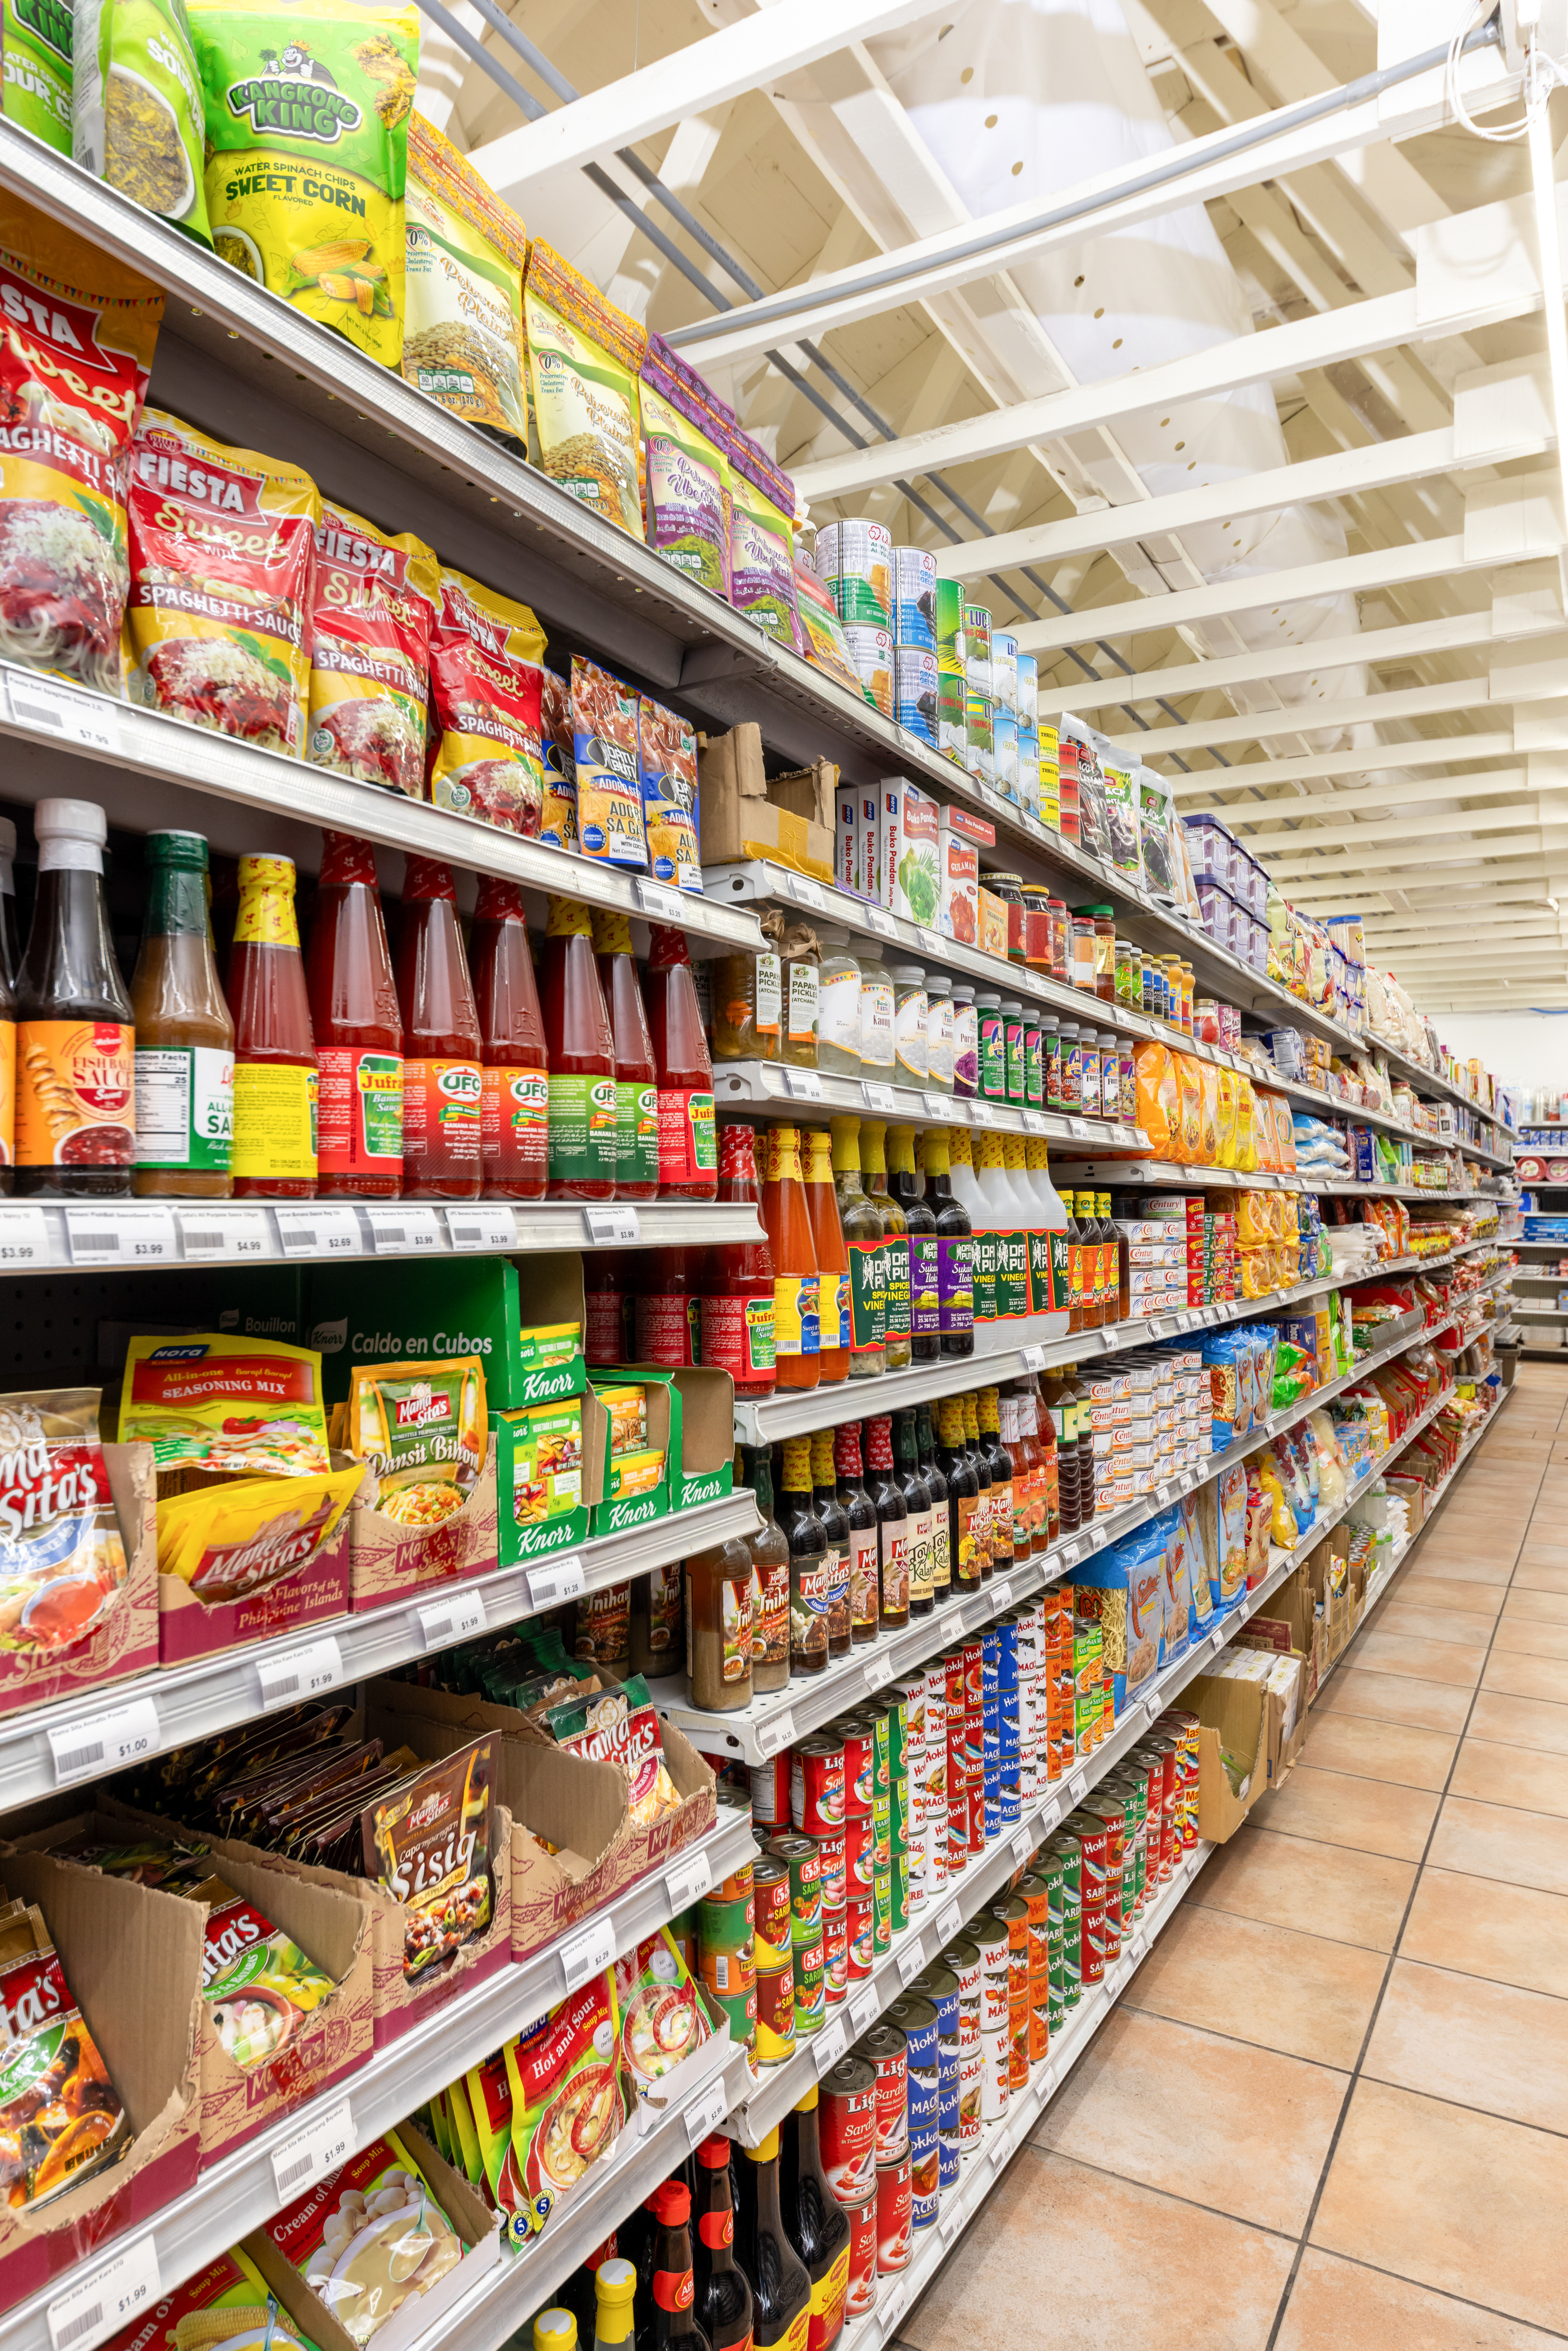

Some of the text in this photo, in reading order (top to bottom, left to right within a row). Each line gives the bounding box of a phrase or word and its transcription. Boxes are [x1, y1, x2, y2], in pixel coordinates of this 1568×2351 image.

[230, 81, 359, 125] KANGKONG
[257, 100, 339, 136] KING
[235, 162, 355, 190] WATER SPINACH CHIPS
[226, 175, 366, 218] SWEET CORN
[273, 194, 313, 207] FLAVORED
[442, 163, 519, 238] EXPORT QUALITY EXPORT QUALITY
[409, 230, 428, 247] 0%
[405, 250, 437, 261] Preservatives
[405, 257, 433, 265] Cholesterol
[440, 257, 510, 326] Polvoron
[538, 260, 602, 319] EXPORT QUALITY EXPORT QUALITY
[457, 292, 506, 340] Plain
[544, 354, 560, 370] 0%
[539, 372, 568, 381] Preservatives
[460, 395, 474, 406] (170
[475, 398, 484, 409] g.)
[570, 377, 629, 430] Polvoron
[586, 406, 625, 443] Plain
[149, 434, 179, 447] WHITE
[152, 442, 176, 453] KING
[139, 452, 246, 513] FIESTA
[667, 473, 700, 499] Ube
[677, 457, 722, 504] Polvoron
[154, 502, 289, 558] Sweet
[315, 527, 396, 577] FIESTA
[324, 572, 416, 629] Sweet
[140, 584, 303, 642] SPAGHETTI SAUCE
[318, 651, 404, 686] SPAGHETTI
[44, 688, 72, 701] Spaghetti
[74, 698, 90, 707] Sauce
[80, 729, 109, 744] $7.99
[459, 715, 523, 751] SPAGHETTI
[598, 778, 627, 794] ADOBO
[907, 811, 938, 826] Buko Pandan
[1140, 807, 1159, 822] BLACK
[606, 817, 625, 833] SA
[973, 821, 984, 831] Pandan
[1214, 846, 1228, 864] Otap
[951, 861, 976, 872] GULAMAN
[668, 910, 681, 918] $3.25
[1215, 907, 1229, 924] Otap
[792, 981, 817, 991] PAPAYA
[792, 988, 817, 999] PICKLES
[792, 997, 816, 1006] (ATCHARA)
[873, 1015, 891, 1028] Kaong
[960, 1033, 976, 1044] Purple
[73, 1057, 105, 1068] FISH
[162, 1053, 187, 1062] Facts
[73, 1069, 133, 1088] SAUCE
[175, 1076, 187, 1084] 25
[362, 1075, 403, 1089] Jufra
[443, 1075, 480, 1092] UFC
[515, 1083, 547, 1098] UFC
[1148, 1200, 1179, 1211] Century
[135, 1244, 162, 1254] $3.99
[237, 1242, 260, 1251] $4.99
[329, 1239, 350, 1247] $2.69
[1, 1248, 32, 1258] $3.99
[959, 1273, 972, 1283] Iloko
[245, 1317, 295, 1333] Bouillon
[312, 1332, 344, 1345] Knorr
[352, 1332, 493, 1354] Caldo en Cubos
[163, 1369, 223, 1382] All-in-one
[162, 1381, 285, 1398] SEASONING MIX
[523, 1373, 575, 1401] Knorr
[399, 1395, 432, 1422] Mama
[416, 1401, 447, 1429] Sita's
[532, 1418, 569, 1432] VEGETABLE BOUILLON
[367, 1435, 479, 1478] Pansit Bihon
[681, 1480, 722, 1506] Knorr
[609, 1500, 657, 1530] Knorr
[199, 1530, 293, 1586] Mama
[909, 1541, 932, 1564] Toyo
[237, 1532, 315, 1591] Sita's
[275, 1579, 340, 1600] Flavors of the
[564, 1584, 579, 1595] $1.25
[305, 1588, 343, 1609] Islands
[811, 1600, 824, 1610] ADOBO
[462, 1617, 479, 1630] $1.99
[311, 1674, 333, 1688] $1.99
[782, 1731, 792, 1741] $4.25
[119, 1738, 147, 1757] $1.00
[410, 1799, 439, 1828] Mama
[424, 1797, 449, 1827] Sita's
[400, 1820, 458, 1863] Capampangan
[392, 1830, 476, 1903] Sisig
[444, 1877, 453, 1888] SPICE
[695, 1881, 706, 1893] $1.99
[639, 1940, 658, 1957] Soup Mix
[596, 1951, 609, 1965] $2.29
[233, 1954, 258, 1985] BAYABAS
[583, 2007, 608, 2031] Soup Mix
[523, 2033, 543, 2049] Kitchen
[532, 1996, 595, 2080] Hot and Sour
[835, 2044, 844, 2057] $1.50
[712, 2105, 723, 2120] $2.99
[273, 2147, 287, 2159] Mama
[288, 2141, 297, 2149] Sita
[307, 2121, 326, 2137] Sinigang
[325, 2108, 344, 2123] Bayabas
[848, 2135, 863, 2144] Tomato
[325, 2142, 345, 2163] $1.99
[352, 2146, 385, 2178] Soup Mix
[273, 2185, 328, 2242] Cream of
[287, 2200, 336, 2256] Crème de Champignons
[517, 2219, 525, 2233] 5
